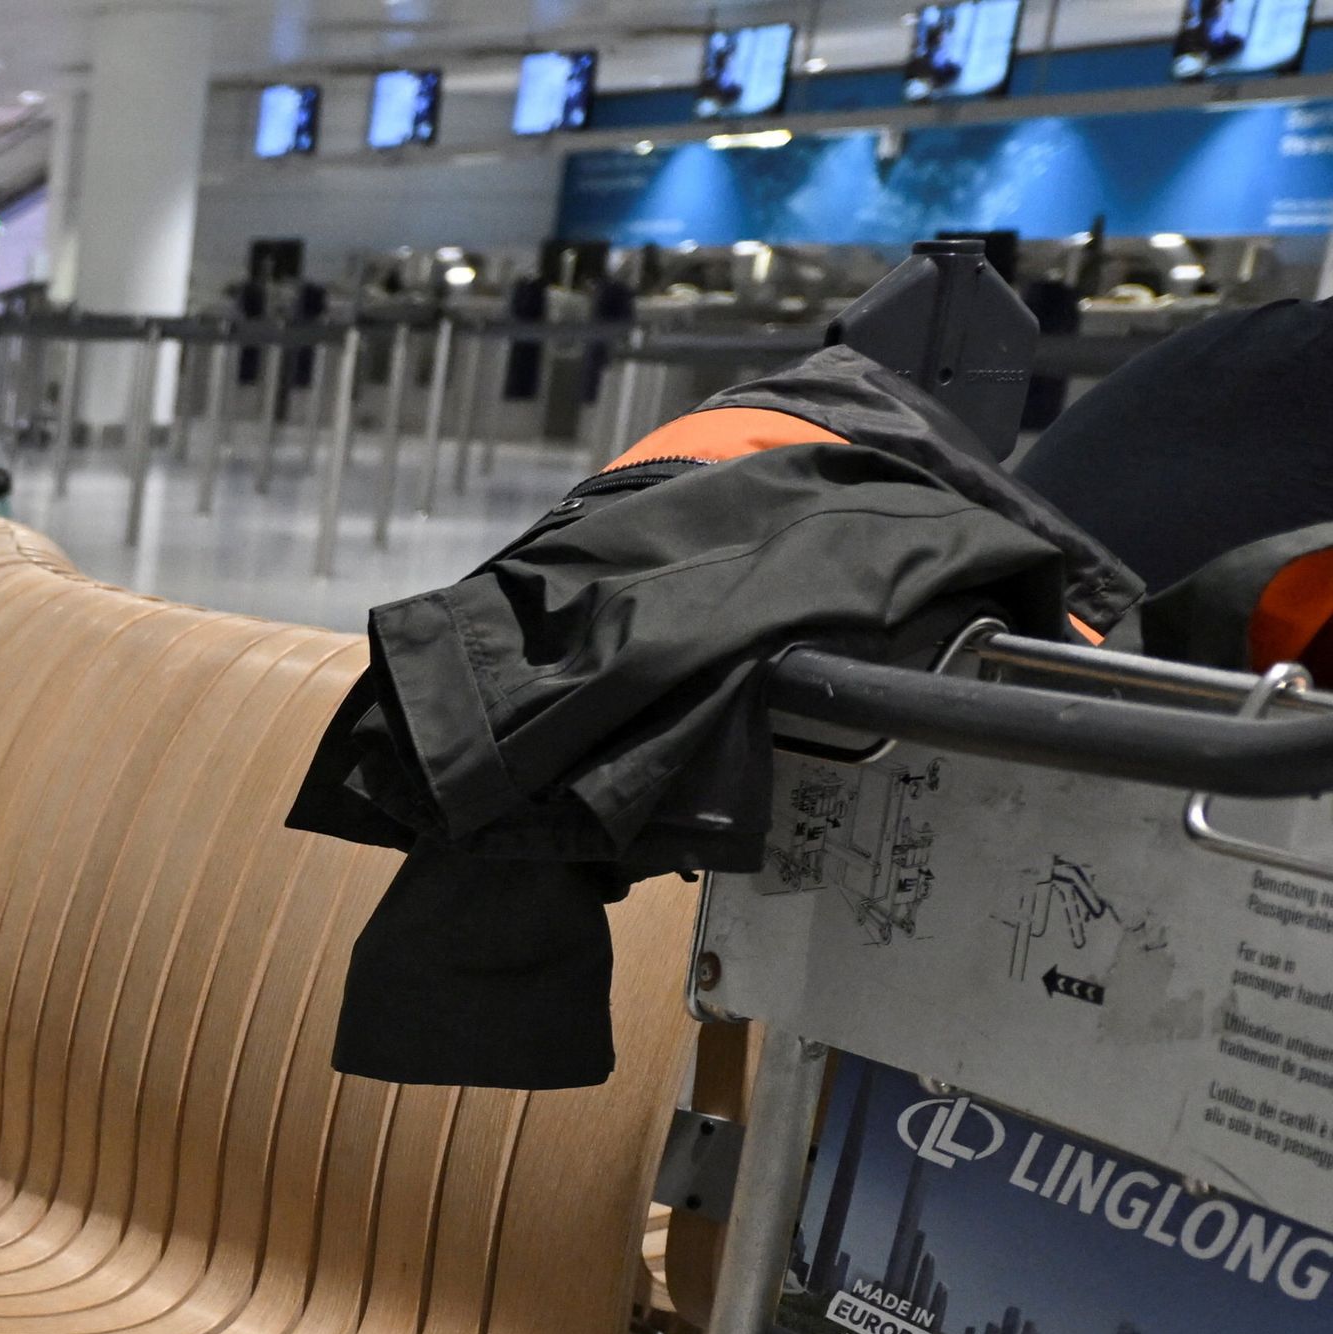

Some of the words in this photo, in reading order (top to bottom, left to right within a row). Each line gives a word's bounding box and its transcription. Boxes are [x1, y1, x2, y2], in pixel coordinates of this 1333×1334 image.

[1232, 969, 1294, 1001] passenger
[1009, 1131, 1333, 1301] LINGLONG
[852, 1278, 912, 1317] MADE
[910, 1306, 935, 1328] IN
